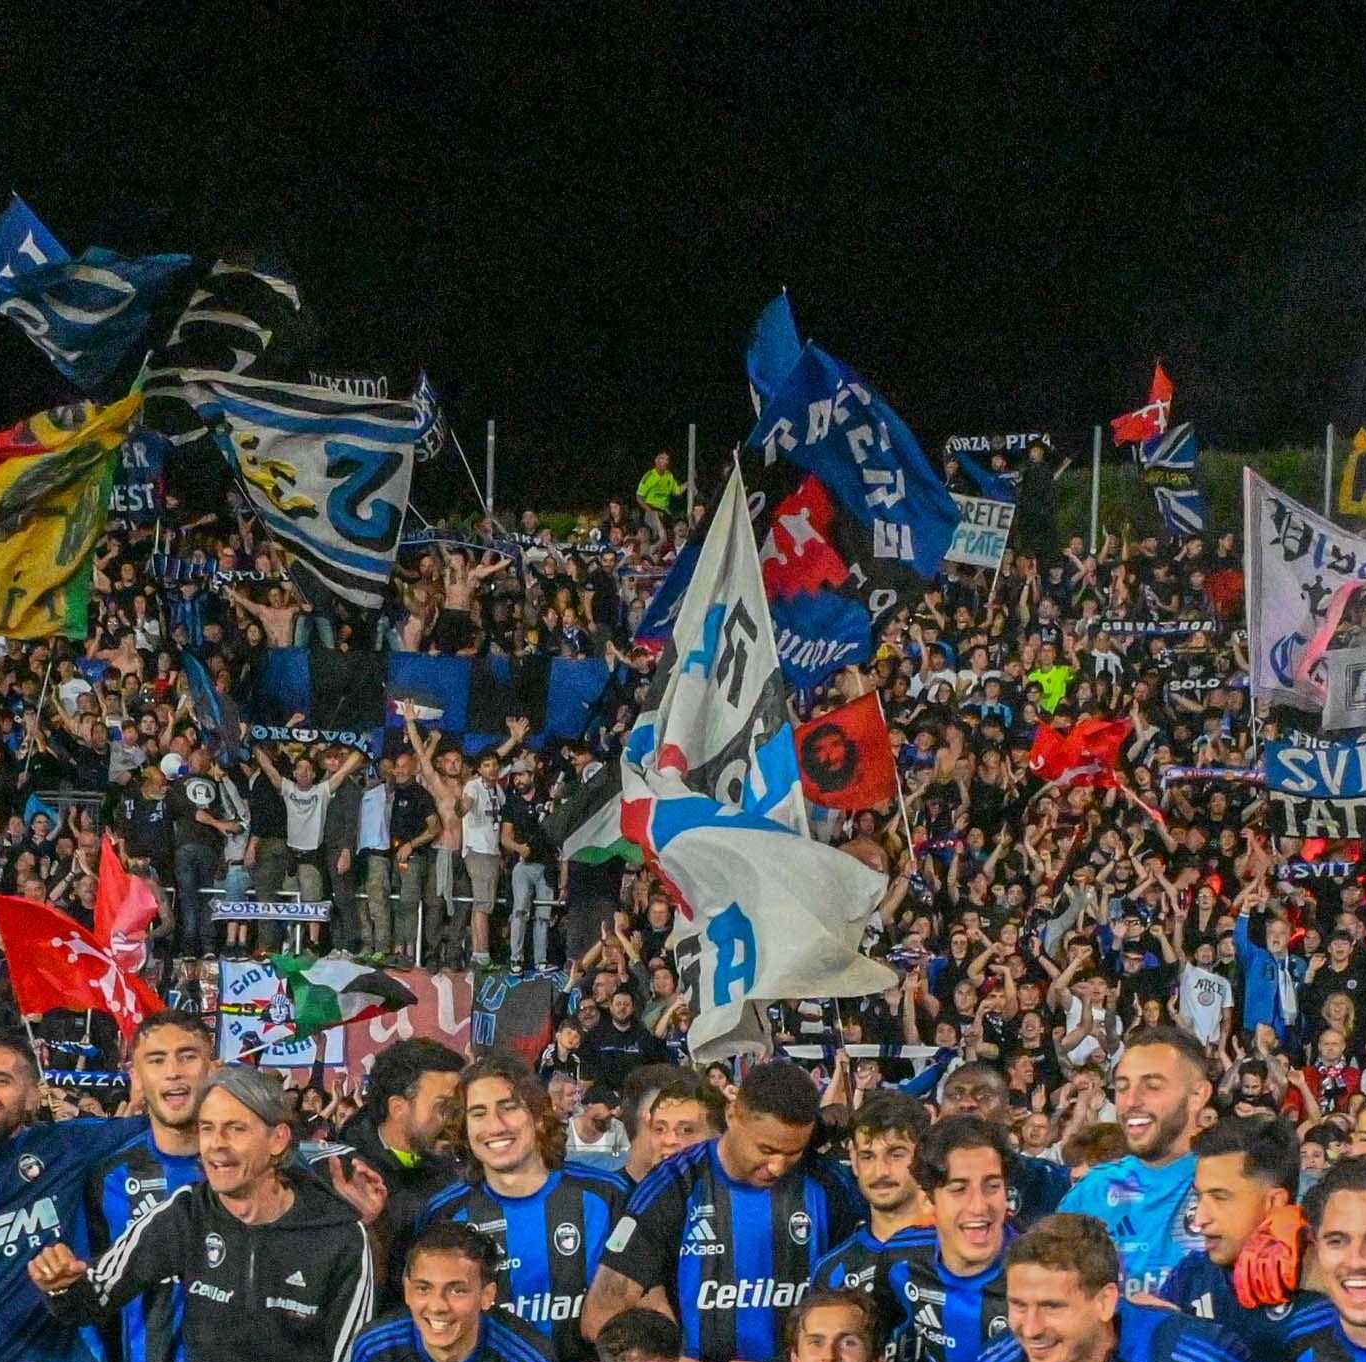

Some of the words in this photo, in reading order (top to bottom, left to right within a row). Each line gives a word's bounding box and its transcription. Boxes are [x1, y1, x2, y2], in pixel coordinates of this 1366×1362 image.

[957, 503, 1012, 530] RETE
[1169, 678, 1221, 691] SOLO
[43, 1070, 127, 1087] PIAZZA
[498, 1287, 589, 1323] etilar
